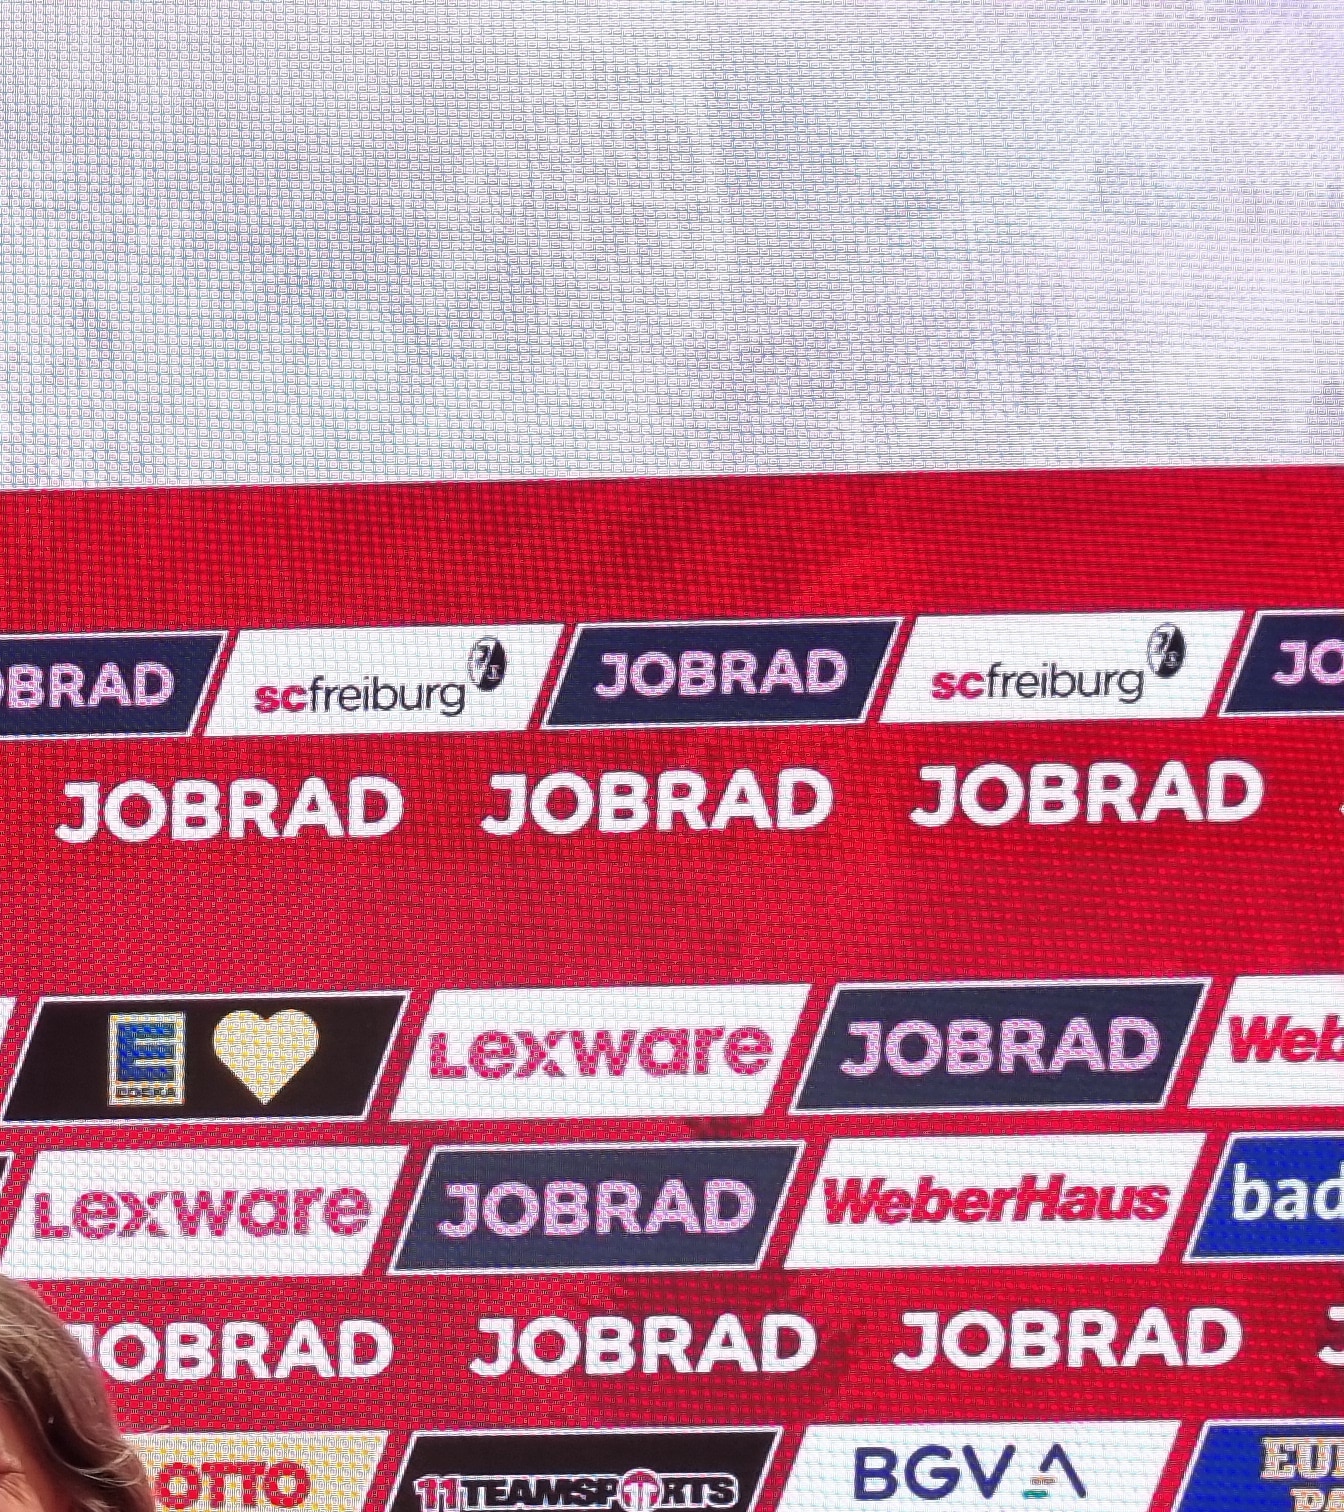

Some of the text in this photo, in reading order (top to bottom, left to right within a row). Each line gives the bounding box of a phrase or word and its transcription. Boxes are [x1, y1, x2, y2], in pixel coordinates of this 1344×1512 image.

[254, 675, 467, 716] scfreiburg
[595, 648, 848, 698] JOBRAD
[931, 660, 1145, 704] scfreiburg
[54, 774, 405, 844] JOBRAD
[480, 767, 834, 838] JOBRAD
[909, 759, 1265, 829] JOBRAD
[428, 1025, 773, 1079] Lexware
[840, 1015, 1161, 1078] JOBRAD
[33, 1185, 371, 1240] Lexware
[438, 1178, 756, 1238] JOBRAD
[822, 1172, 1171, 1225] WeberHaus
[468, 1311, 818, 1377] JOBRAD
[892, 1306, 1244, 1371] JOBRAD
